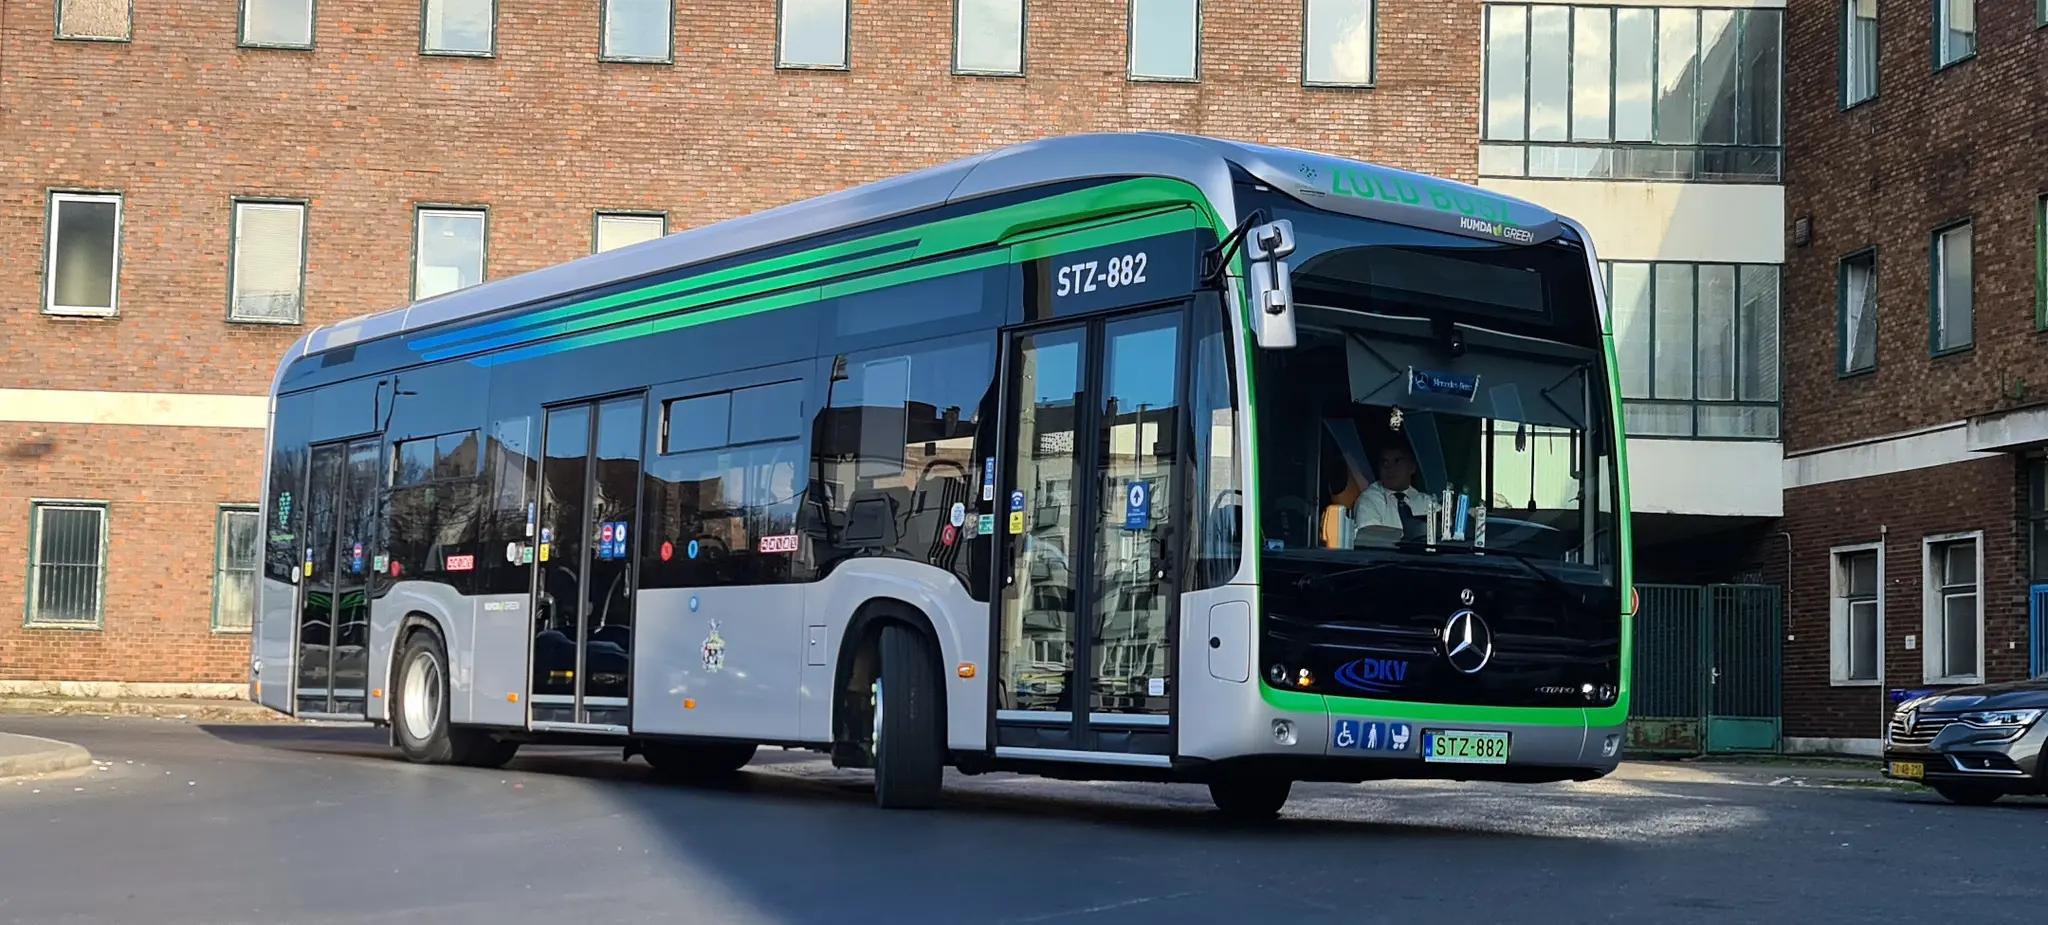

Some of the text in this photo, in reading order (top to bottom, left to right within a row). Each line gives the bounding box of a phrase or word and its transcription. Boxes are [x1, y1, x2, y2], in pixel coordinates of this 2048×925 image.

[1460, 217, 1534, 242] HUMDA GREEN
[1057, 252, 1147, 297] STZ-882
[1364, 658, 1408, 681] DKV
[1436, 737, 1504, 757] STZ-882
